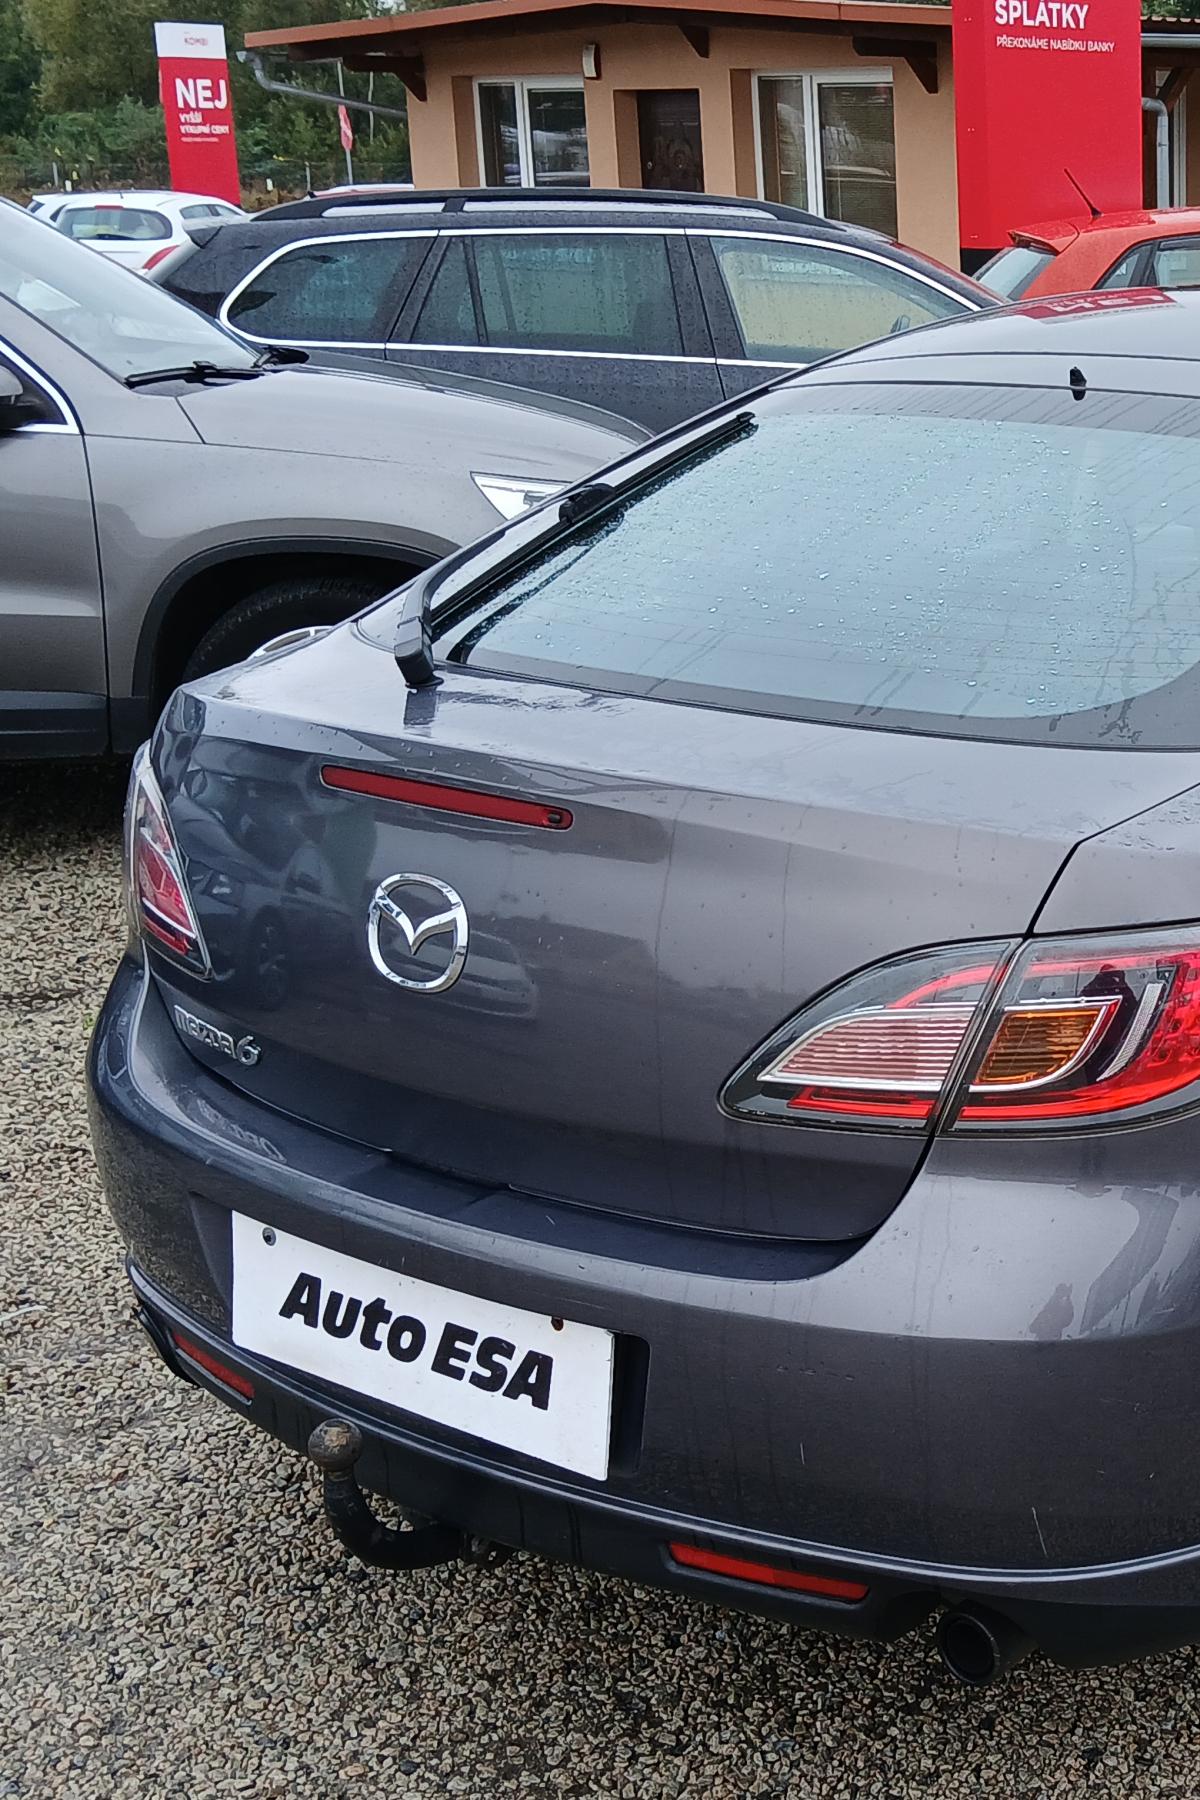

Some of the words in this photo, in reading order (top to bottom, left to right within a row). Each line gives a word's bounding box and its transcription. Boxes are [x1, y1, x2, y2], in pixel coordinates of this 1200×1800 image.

[995, 0, 1089, 29] SPLÁTKY
[996, 34, 1048, 50] PŘEKONÁME
[1050, 37, 1086, 51] NABÍDKU
[1088, 41, 1115, 53] BANKY
[175, 77, 228, 109] NEJ
[279, 1272, 427, 1363] Auto
[431, 1321, 554, 1412] ESA
